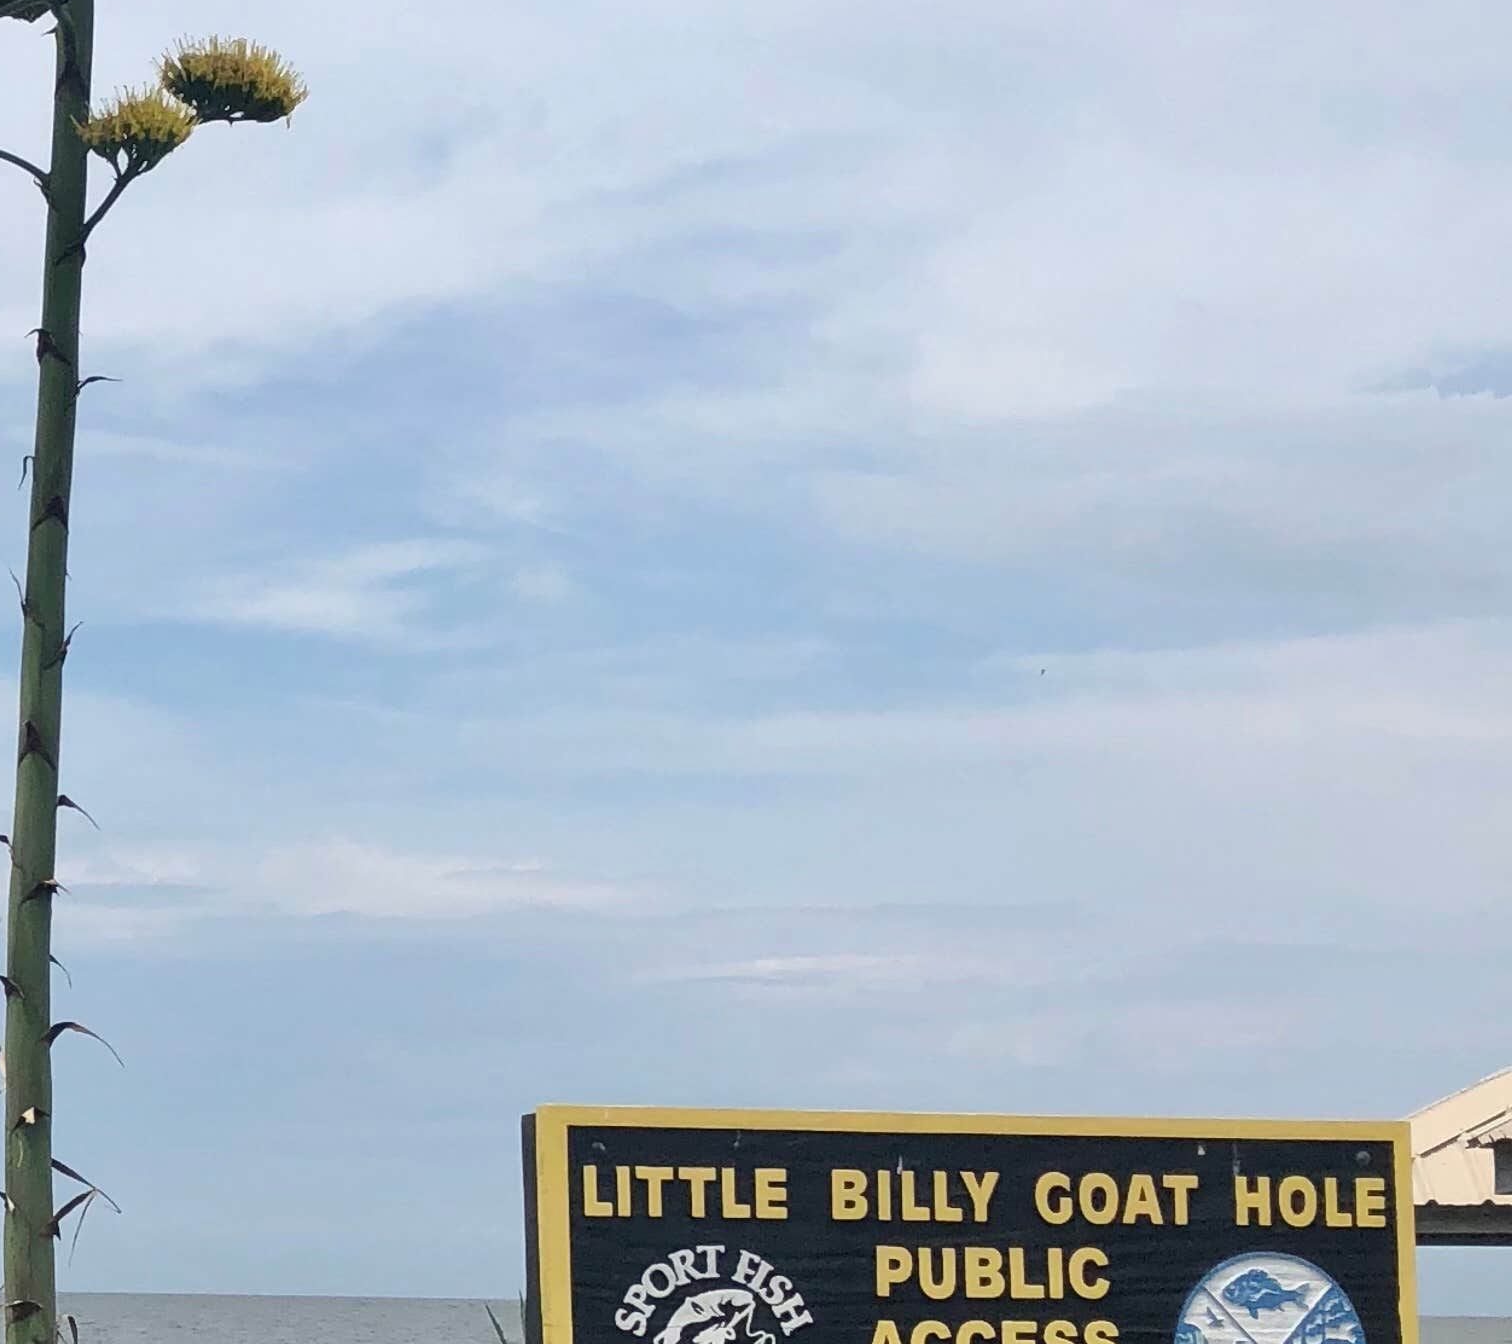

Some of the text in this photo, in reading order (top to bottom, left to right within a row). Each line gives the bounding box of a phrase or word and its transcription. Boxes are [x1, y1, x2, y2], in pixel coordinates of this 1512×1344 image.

[583, 1164, 1386, 1228] LITTLE BILLY GOAT HOLE
[615, 1245, 814, 1336] SPORT FISH
[876, 1245, 1111, 1300] PUBLIC
